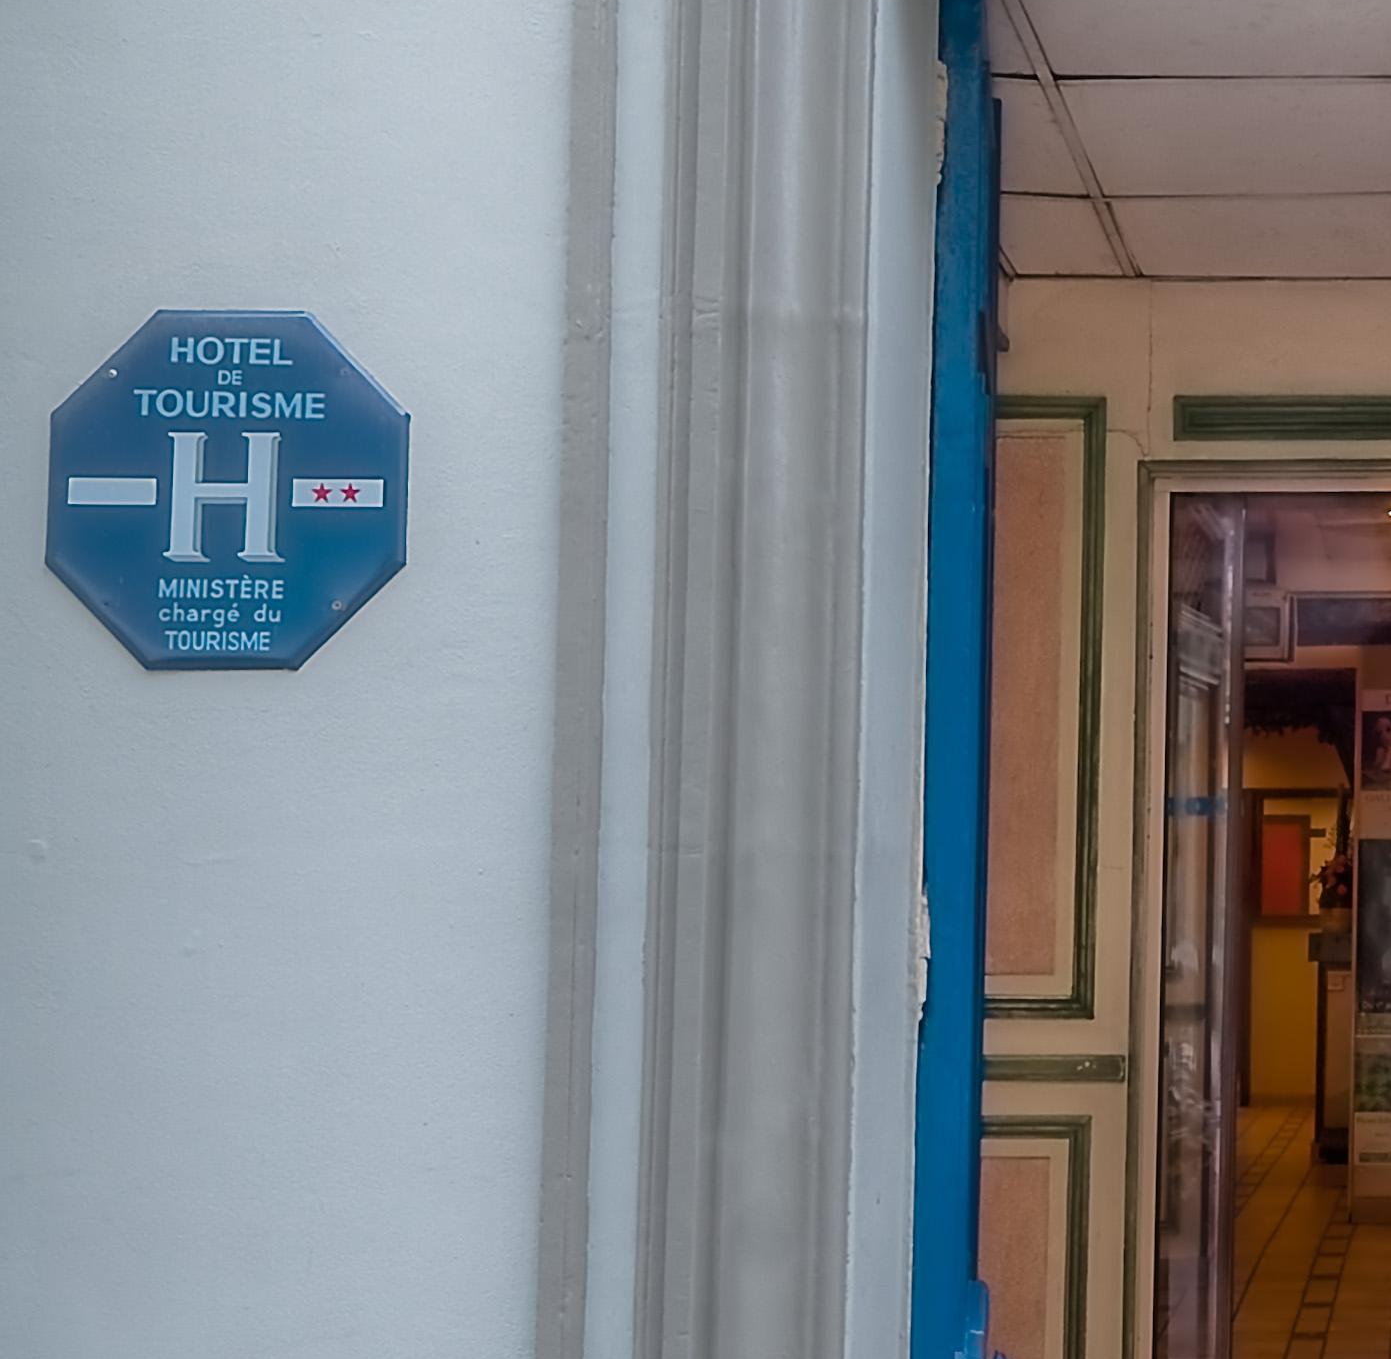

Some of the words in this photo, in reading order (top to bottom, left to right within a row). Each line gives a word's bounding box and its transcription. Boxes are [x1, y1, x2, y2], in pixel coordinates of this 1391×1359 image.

[169, 336, 294, 366] HOTEL
[217, 369, 243, 386] DE
[133, 389, 326, 420] TOURISME
[162, 431, 286, 563] H
[158, 574, 285, 599] MINISTÈRE
[158, 602, 241, 629] chargé
[253, 601, 282, 623] du
[165, 630, 271, 652] TOURISME
